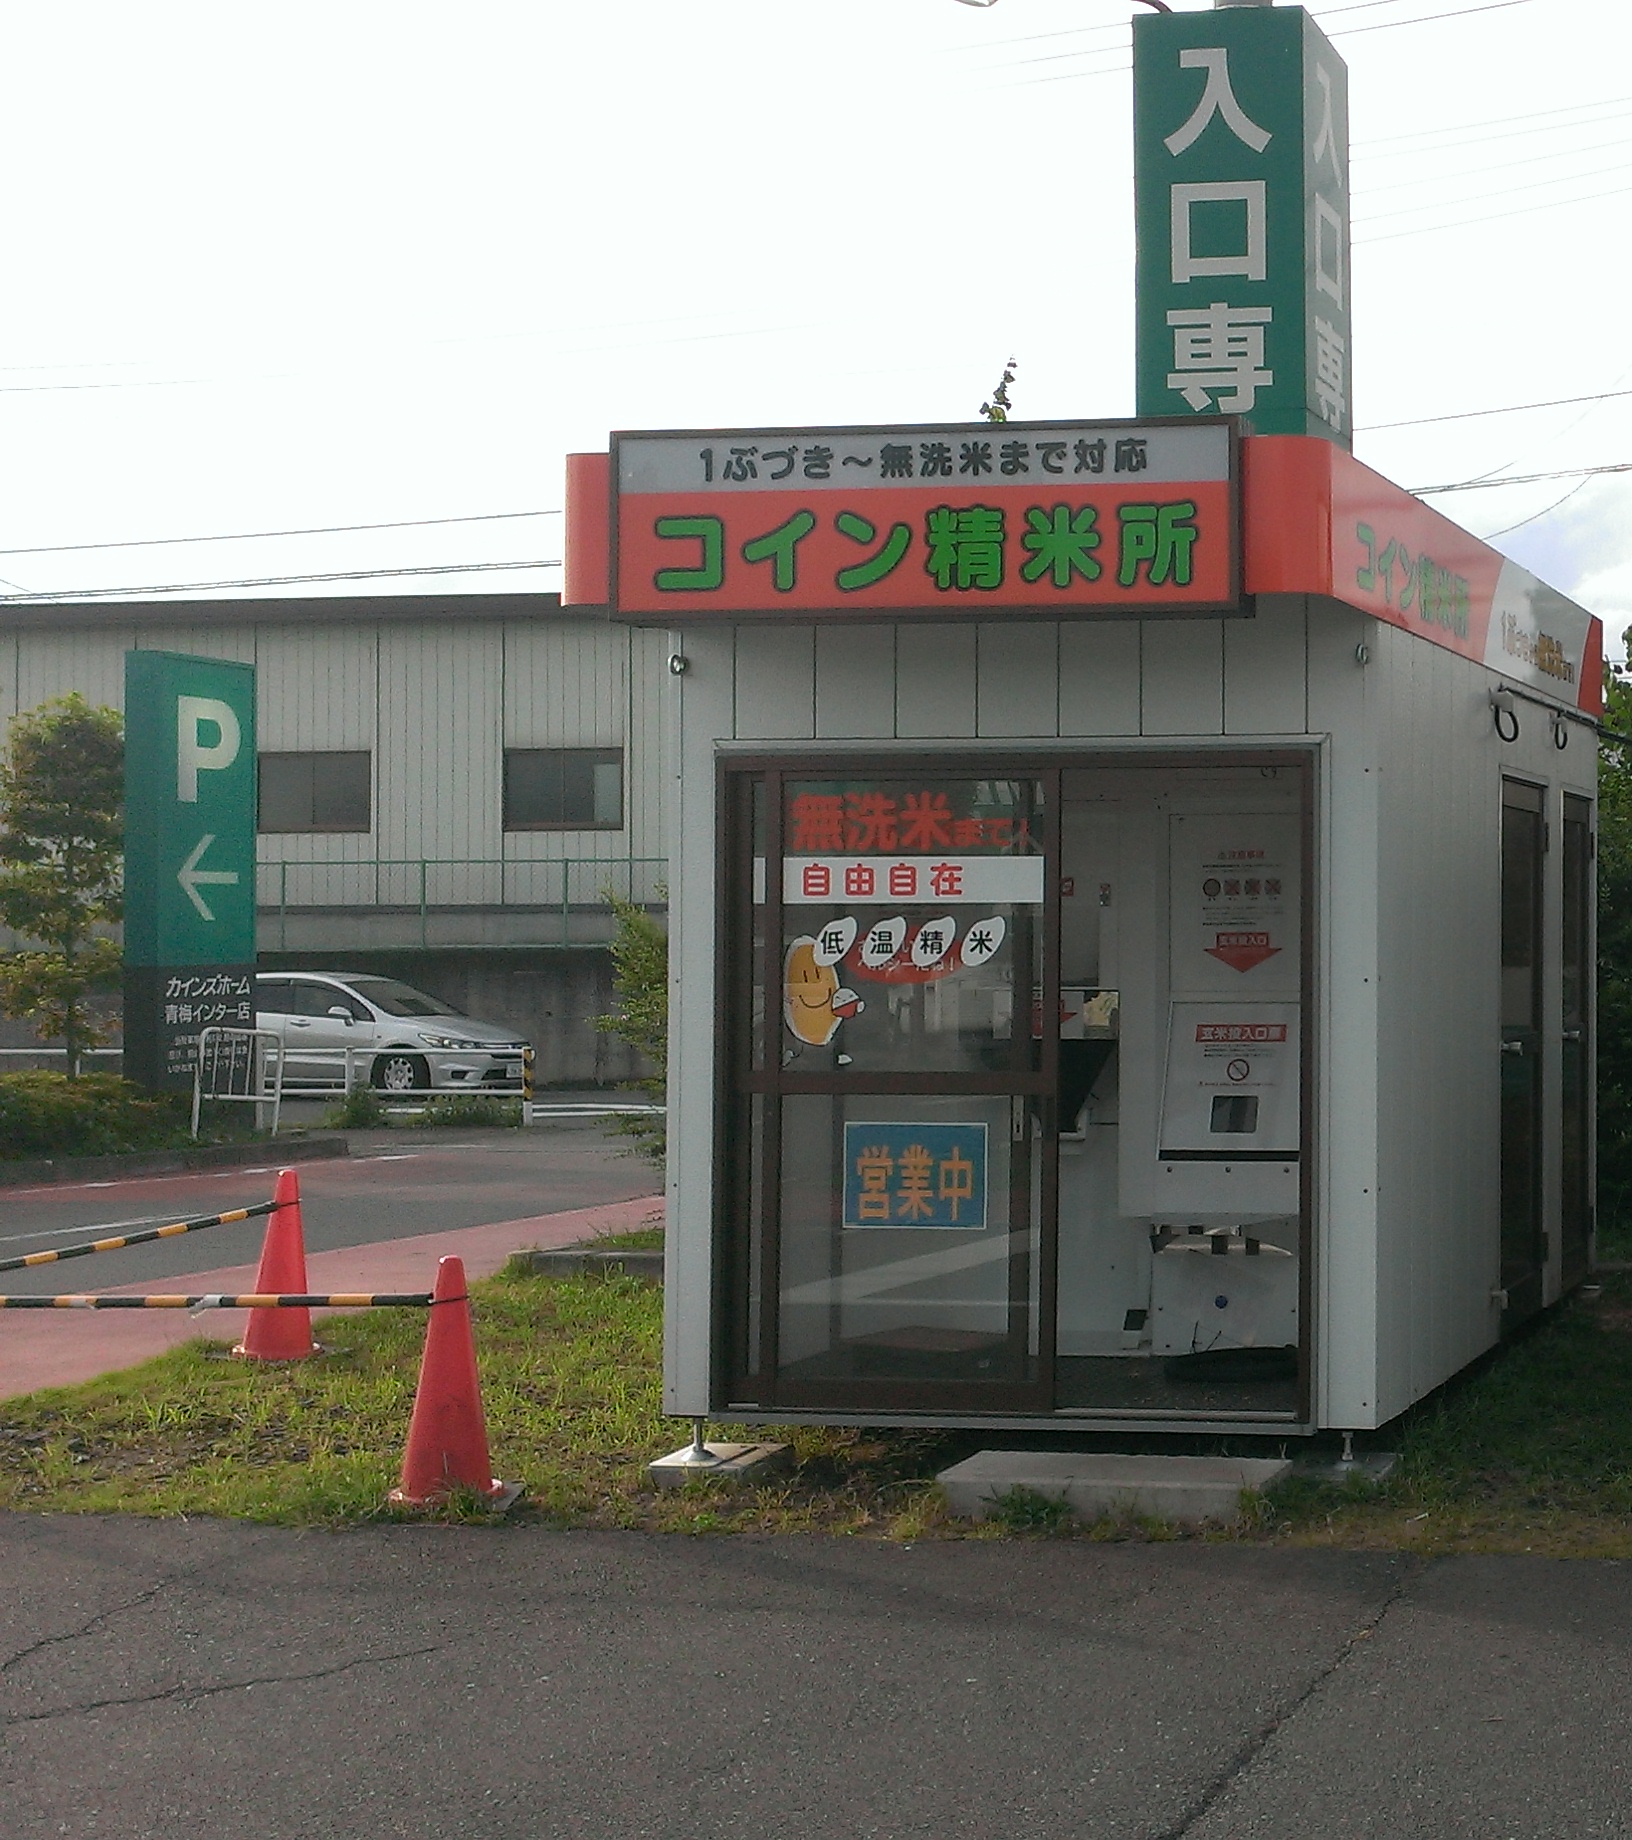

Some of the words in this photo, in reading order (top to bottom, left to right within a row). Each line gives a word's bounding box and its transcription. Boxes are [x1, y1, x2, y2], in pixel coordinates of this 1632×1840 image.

[1163, 47, 1273, 414] 入口専
[1312, 61, 1345, 434] 入口専
[652, 500, 1201, 592] コイン精米所
[176, 694, 242, 804] P
[802, 863, 963, 897] 自由自在
[820, 930, 994, 955] 低温精米
[165, 1001, 251, 1024] 青梅インター店
[166, 973, 251, 998] カインズホーム
[856, 1144, 974, 1221] 営業中
